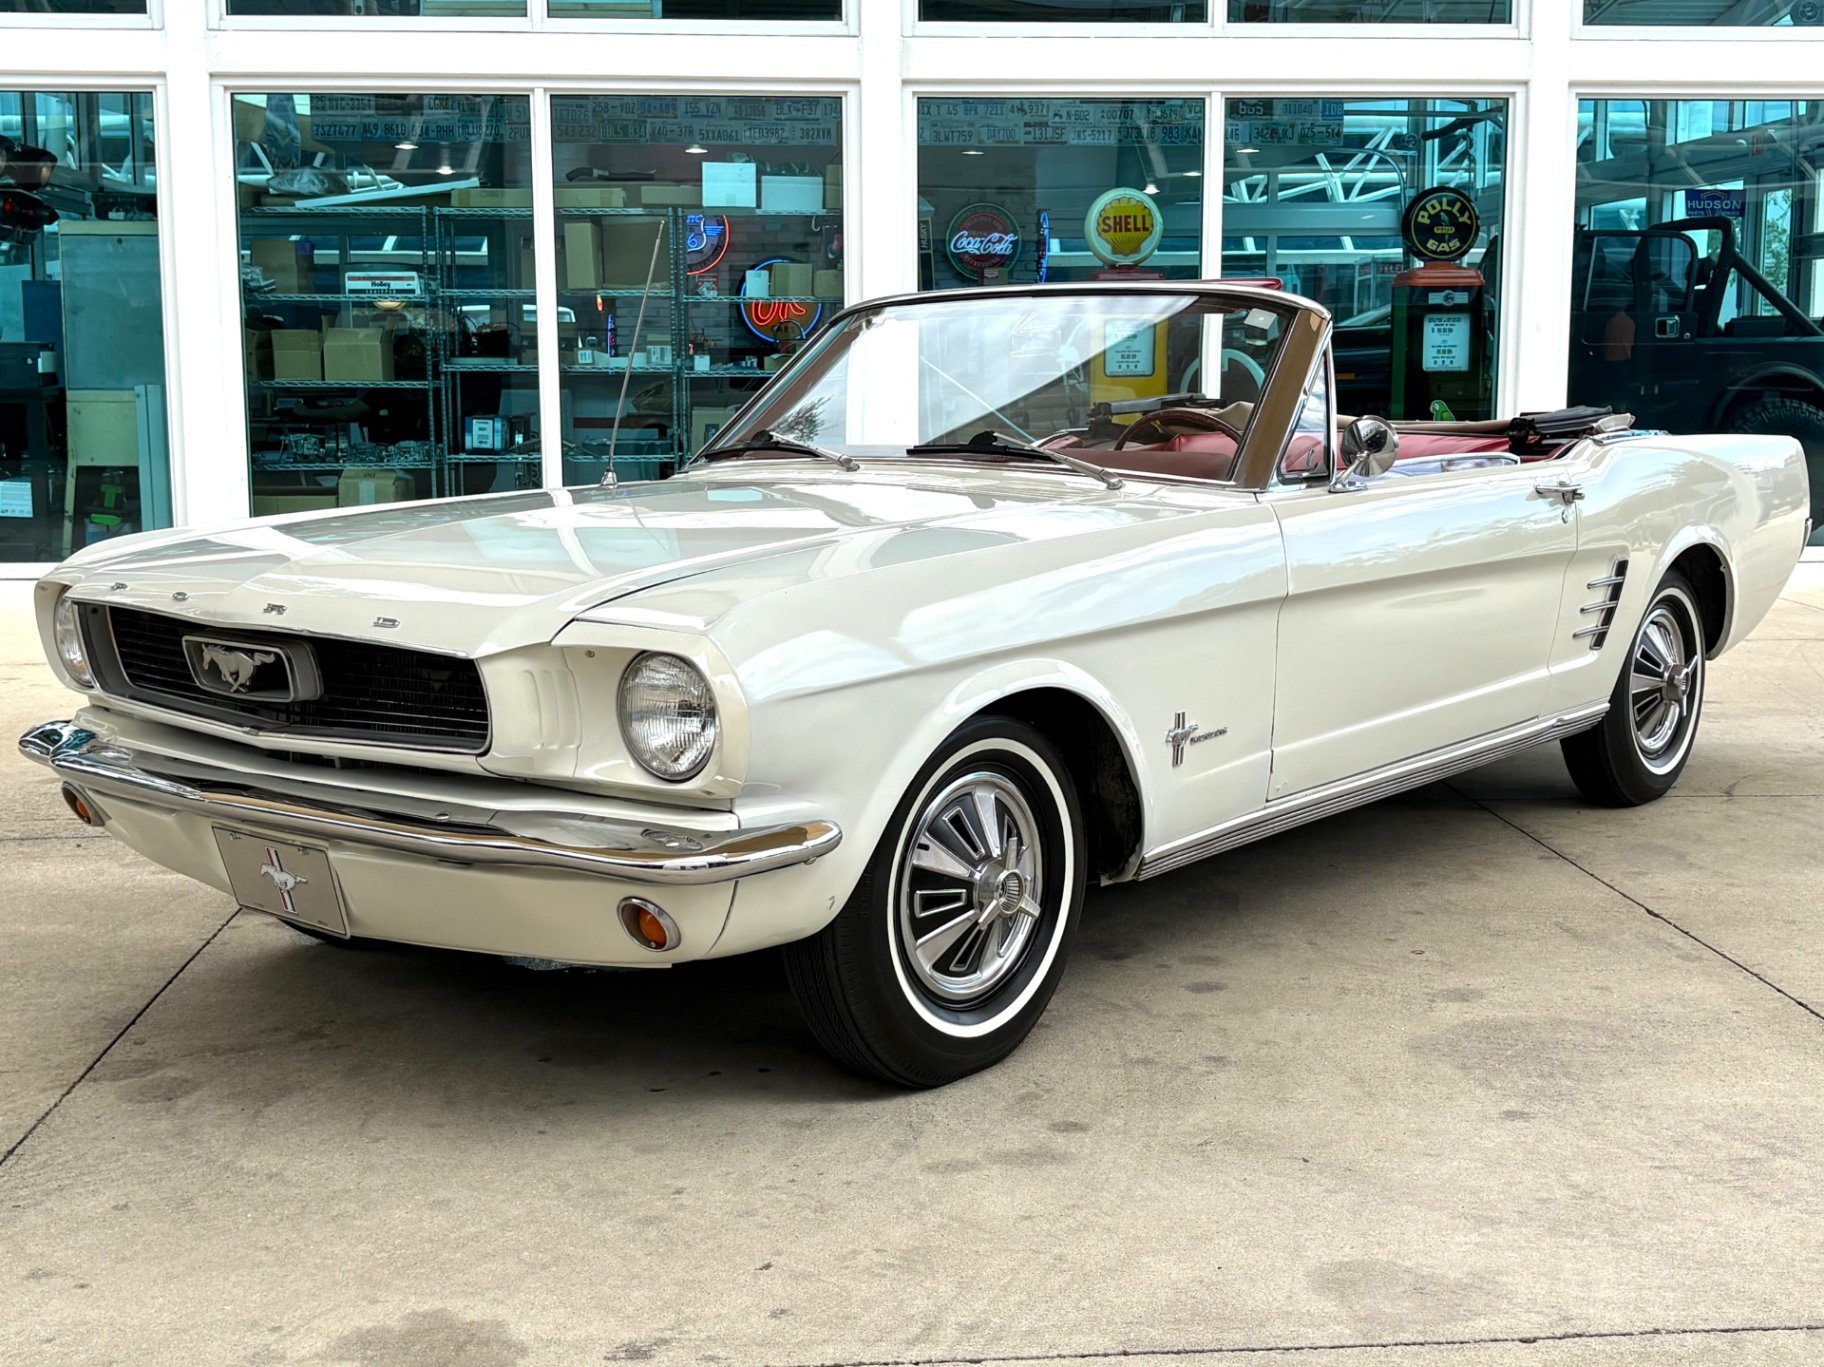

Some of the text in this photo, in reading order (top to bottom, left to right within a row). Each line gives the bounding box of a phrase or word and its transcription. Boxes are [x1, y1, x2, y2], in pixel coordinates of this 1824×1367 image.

[1416, 197, 1472, 225] POLLY
[1687, 200, 1742, 210] HUDSON
[1101, 214, 1151, 234] SHELL
[951, 230, 1018, 256] Coca-Cola
[1425, 238, 1461, 253] GAS
